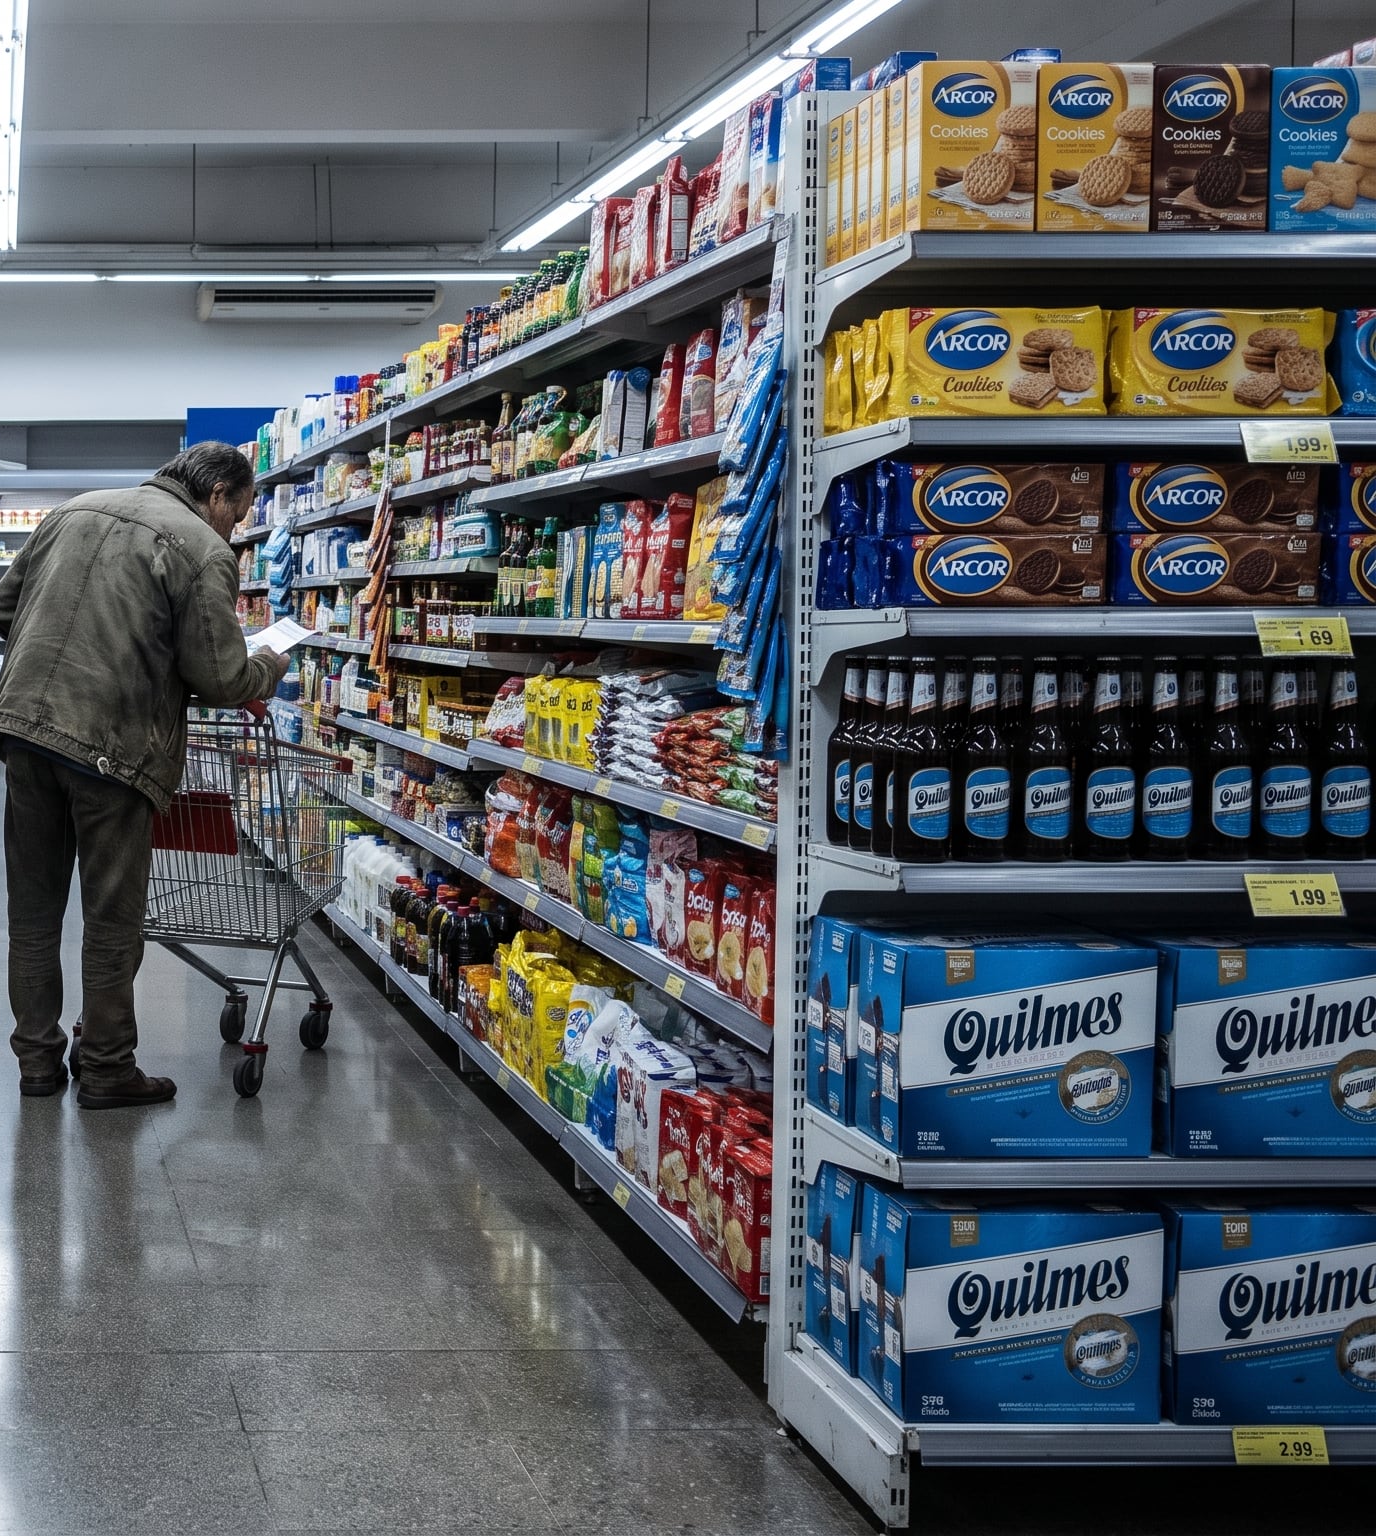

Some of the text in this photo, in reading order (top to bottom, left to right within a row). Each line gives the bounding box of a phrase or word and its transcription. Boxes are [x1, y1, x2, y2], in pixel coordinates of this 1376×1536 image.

[934, 87, 995, 105] ARCOR
[1050, 89, 1112, 107] ARCOR
[1167, 90, 1228, 108] ARCOR
[1283, 91, 1345, 109] ARCOR
[929, 124, 989, 138] Cookies
[1046, 127, 1105, 141] Cookies
[1162, 127, 1221, 141] Cookies
[1279, 128, 1338, 142] Cookies
[928, 330, 1008, 352] ARCOR
[1153, 329, 1234, 352] ARCOR
[1284, 437, 1321, 454] 1,99
[929, 486, 1006, 507] ARCOR
[1147, 484, 1223, 506] ARCOR
[930, 555, 1008, 576] ARCOR
[1147, 555, 1225, 576] ARCOR
[1290, 889, 1326, 906] 1.99
[943, 991, 1123, 1076] Quilmes
[1215, 993, 1376, 1075] Quilme
[947, 1254, 1130, 1340] Quilmes
[1279, 1442, 1312, 1457] 2.99
